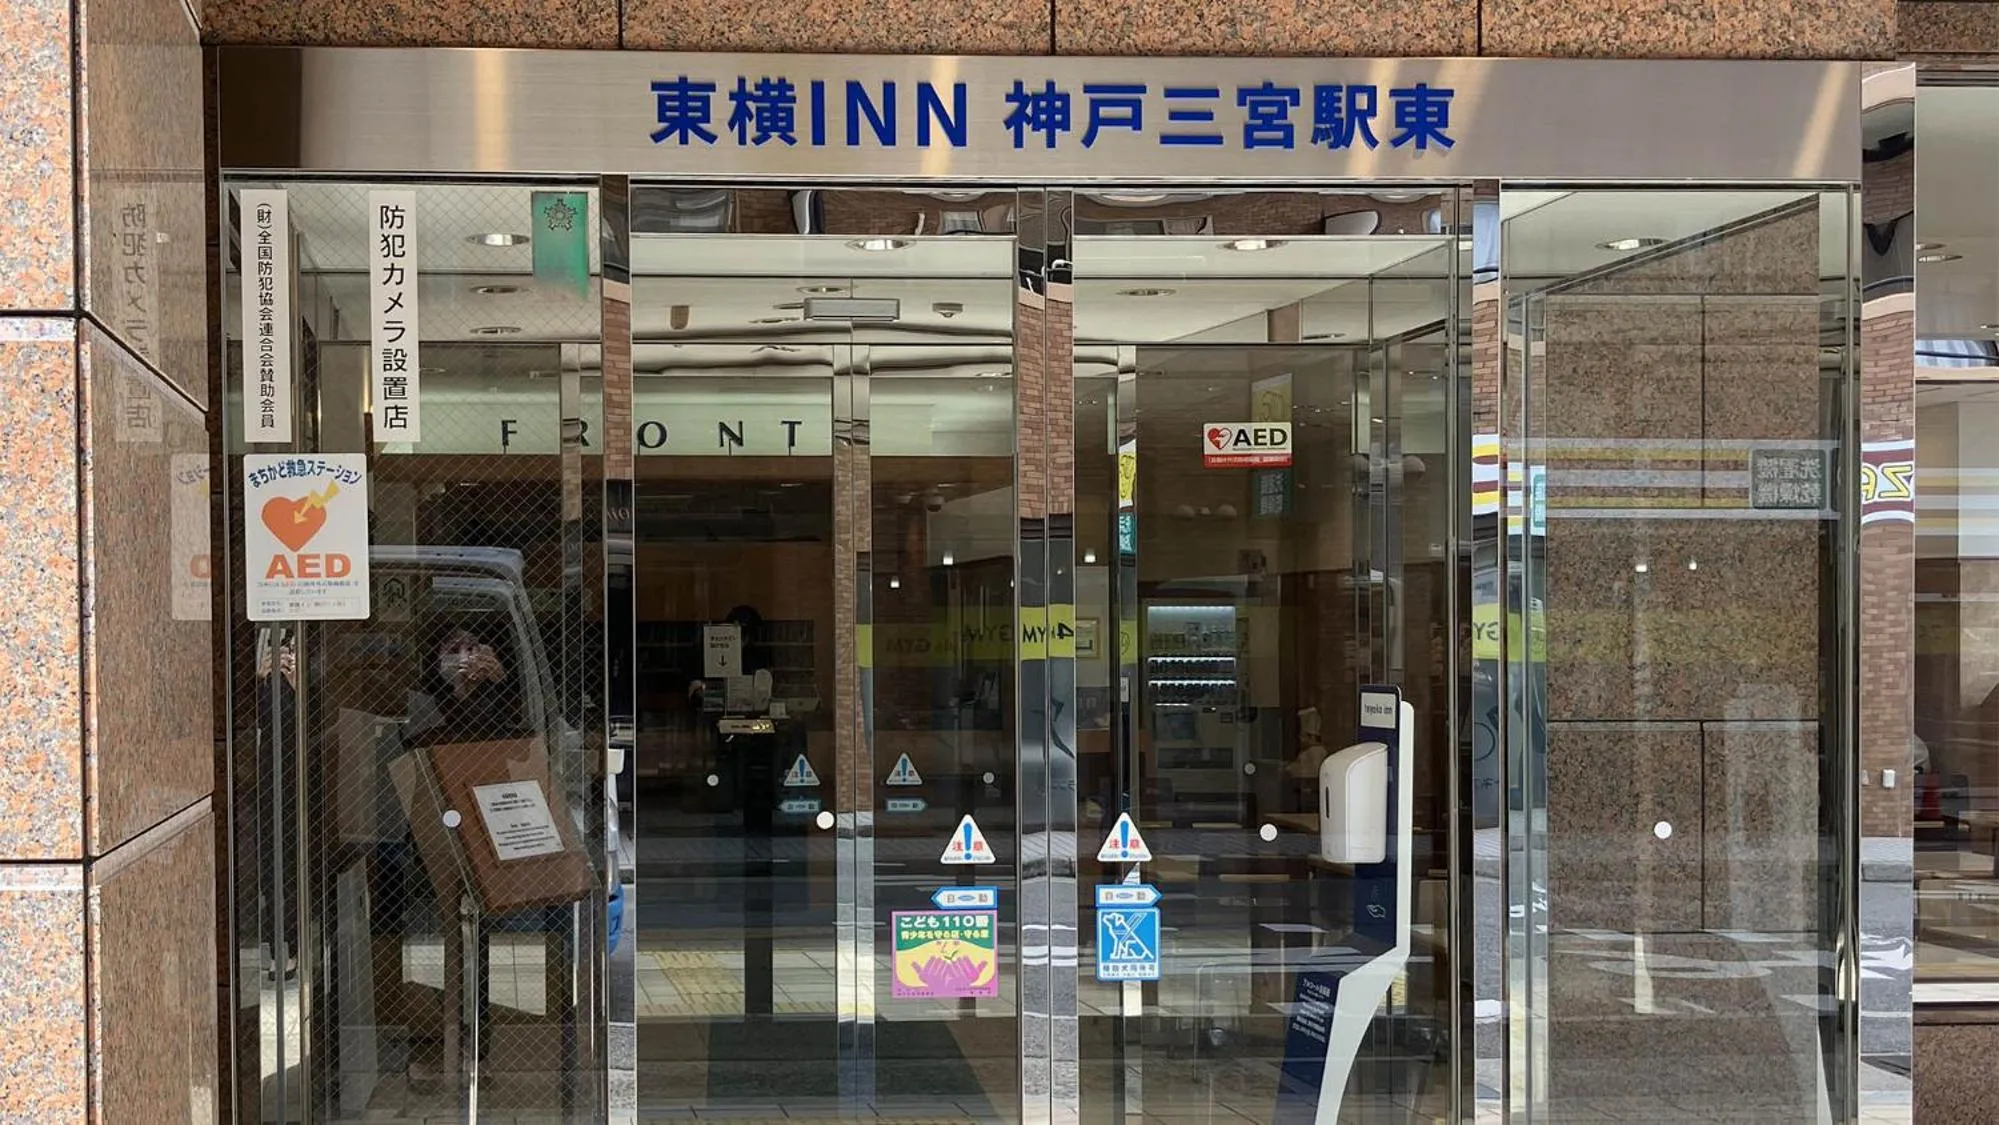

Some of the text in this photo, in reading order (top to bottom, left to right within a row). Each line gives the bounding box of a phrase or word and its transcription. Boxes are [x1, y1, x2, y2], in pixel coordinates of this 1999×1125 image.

[649, 75, 1456, 150] 東横INN 神戸三宮駅東
[379, 204, 409, 430] 防犯カメラ設置店
[1232, 428, 1289, 447] AED
[247, 458, 362, 489] まちかど救急ステーション
[264, 553, 352, 580] AED
